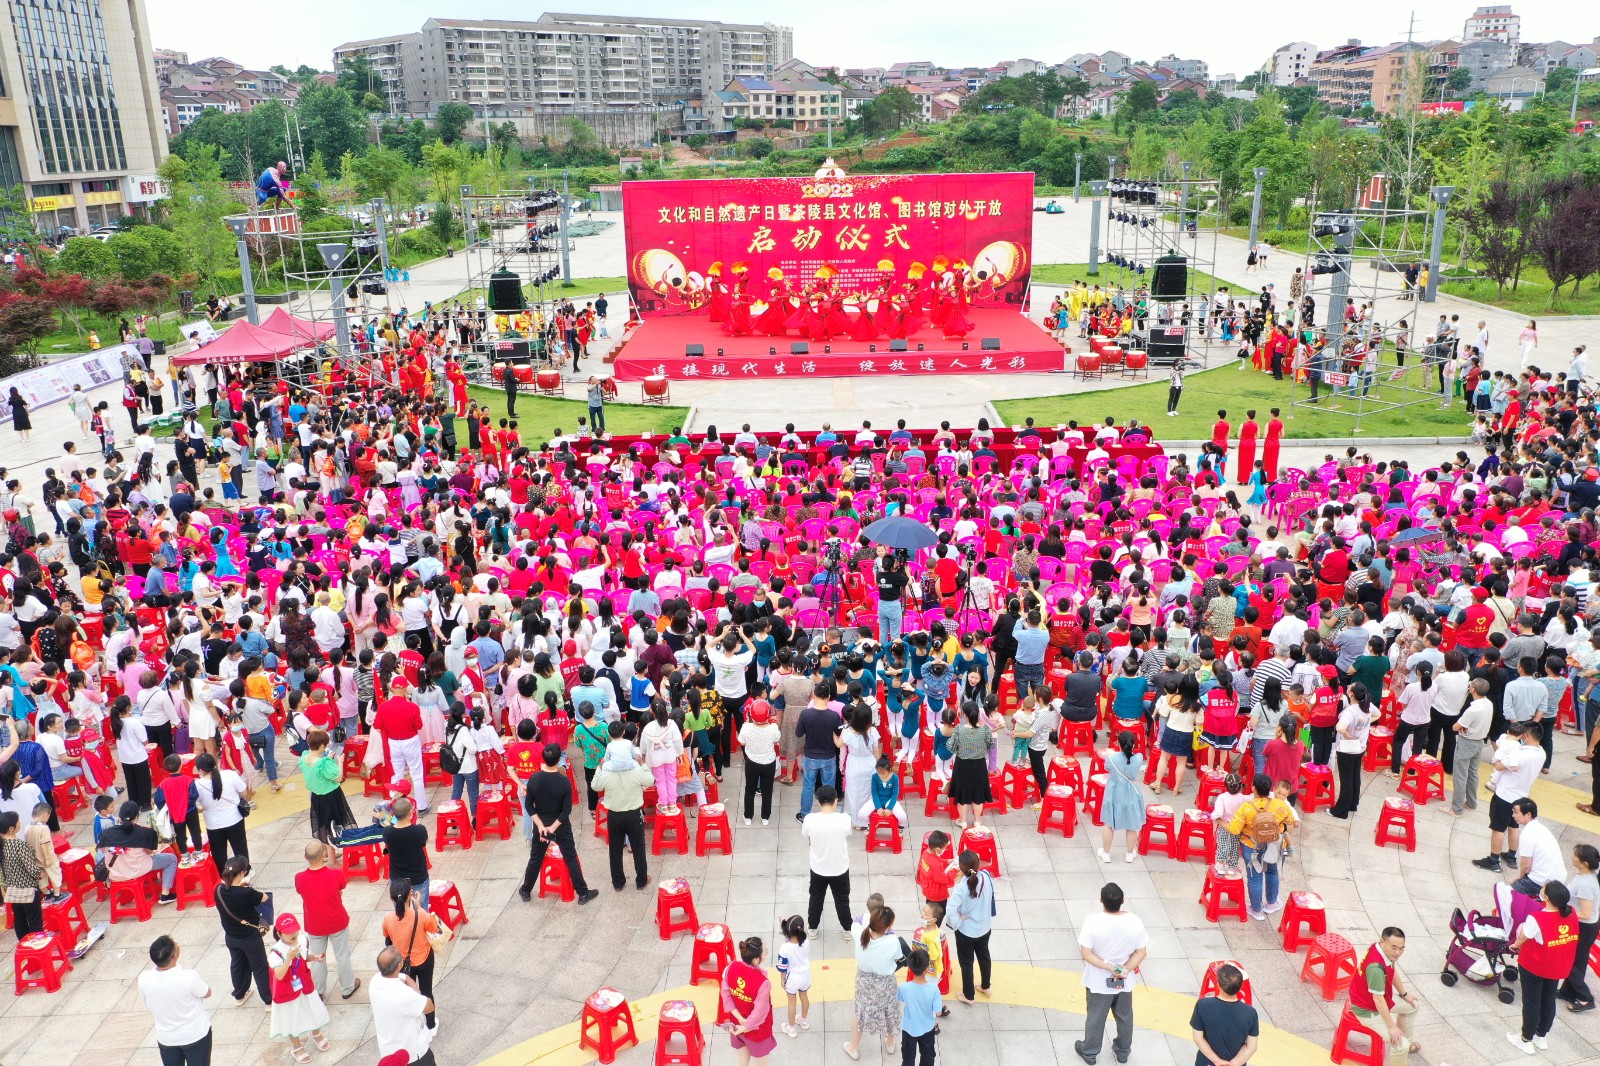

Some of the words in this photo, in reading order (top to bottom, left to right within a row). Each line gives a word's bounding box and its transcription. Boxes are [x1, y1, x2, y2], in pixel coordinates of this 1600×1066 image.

[801, 182, 854, 199] 2022
[747, 223, 910, 254] 启动仪式
[652, 360, 817, 378] 连接现代生活
[859, 355, 1026, 372] 绽放迷人光彩
